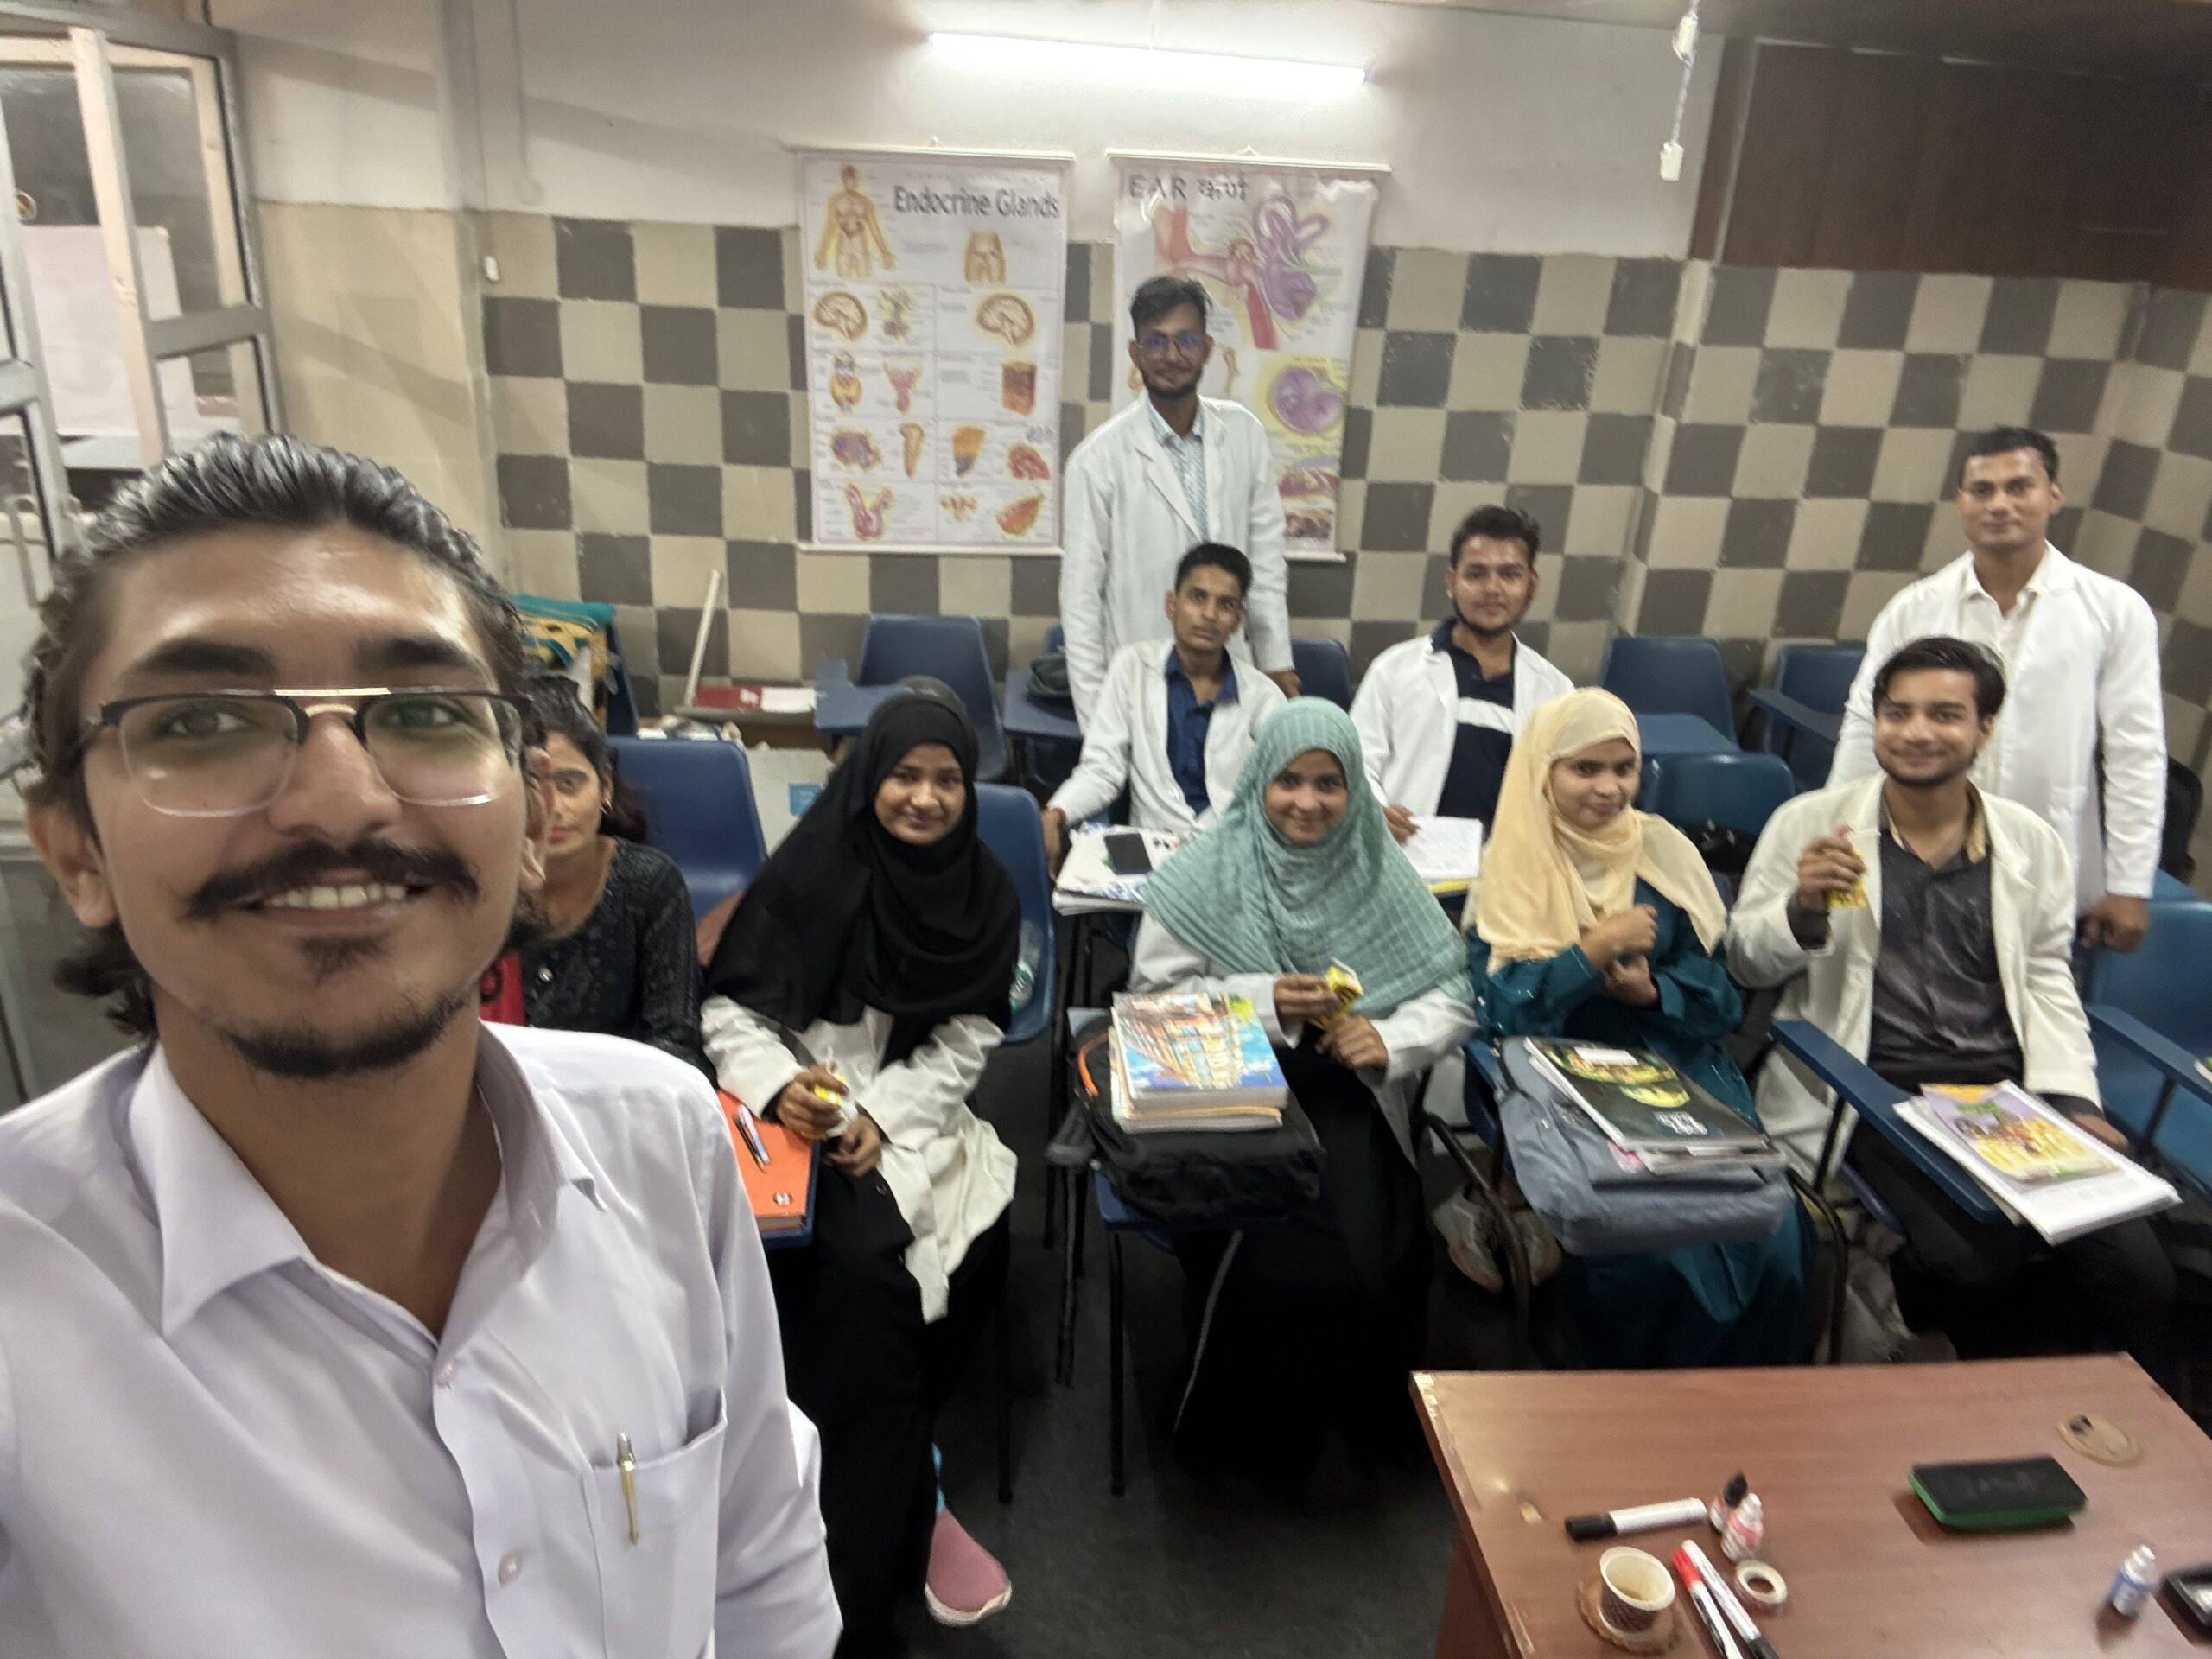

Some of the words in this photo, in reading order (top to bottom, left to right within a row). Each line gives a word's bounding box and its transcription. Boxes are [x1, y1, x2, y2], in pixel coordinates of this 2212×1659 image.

[893, 184, 991, 215] Endocrine
[995, 188, 1060, 218] Glands
[1128, 174, 1187, 200] EAR
